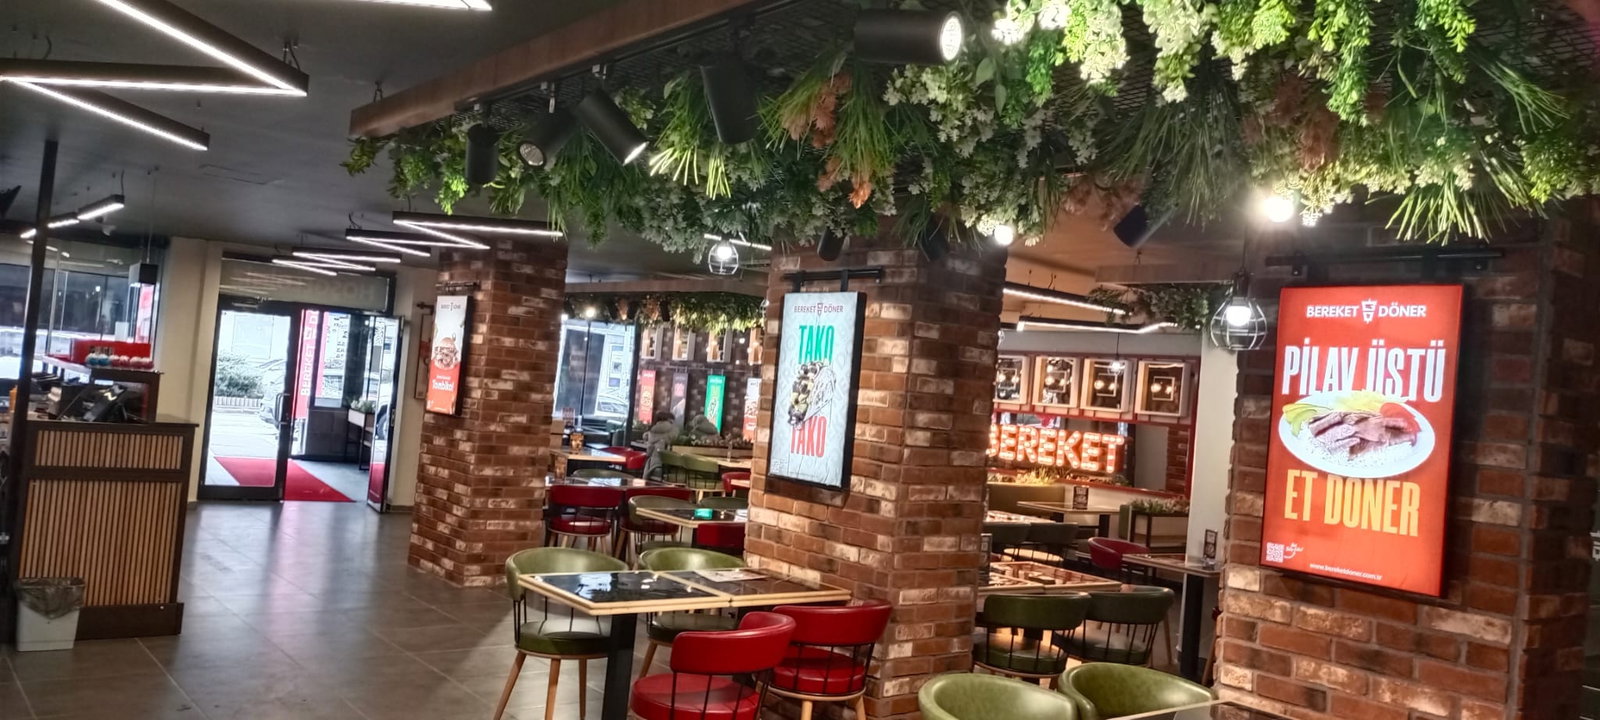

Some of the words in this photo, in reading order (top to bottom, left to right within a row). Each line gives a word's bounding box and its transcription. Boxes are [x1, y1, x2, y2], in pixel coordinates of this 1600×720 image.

[823, 303, 844, 313] DÖNER
[1306, 304, 1359, 318] BEREKET
[1377, 301, 1427, 318] DÖNER
[798, 325, 835, 365] TAKO
[1281, 337, 1360, 396] PİLAV
[1365, 339, 1446, 403] ÜSTÜ
[790, 415, 828, 458] TAKO
[1284, 469, 1318, 522] ET
